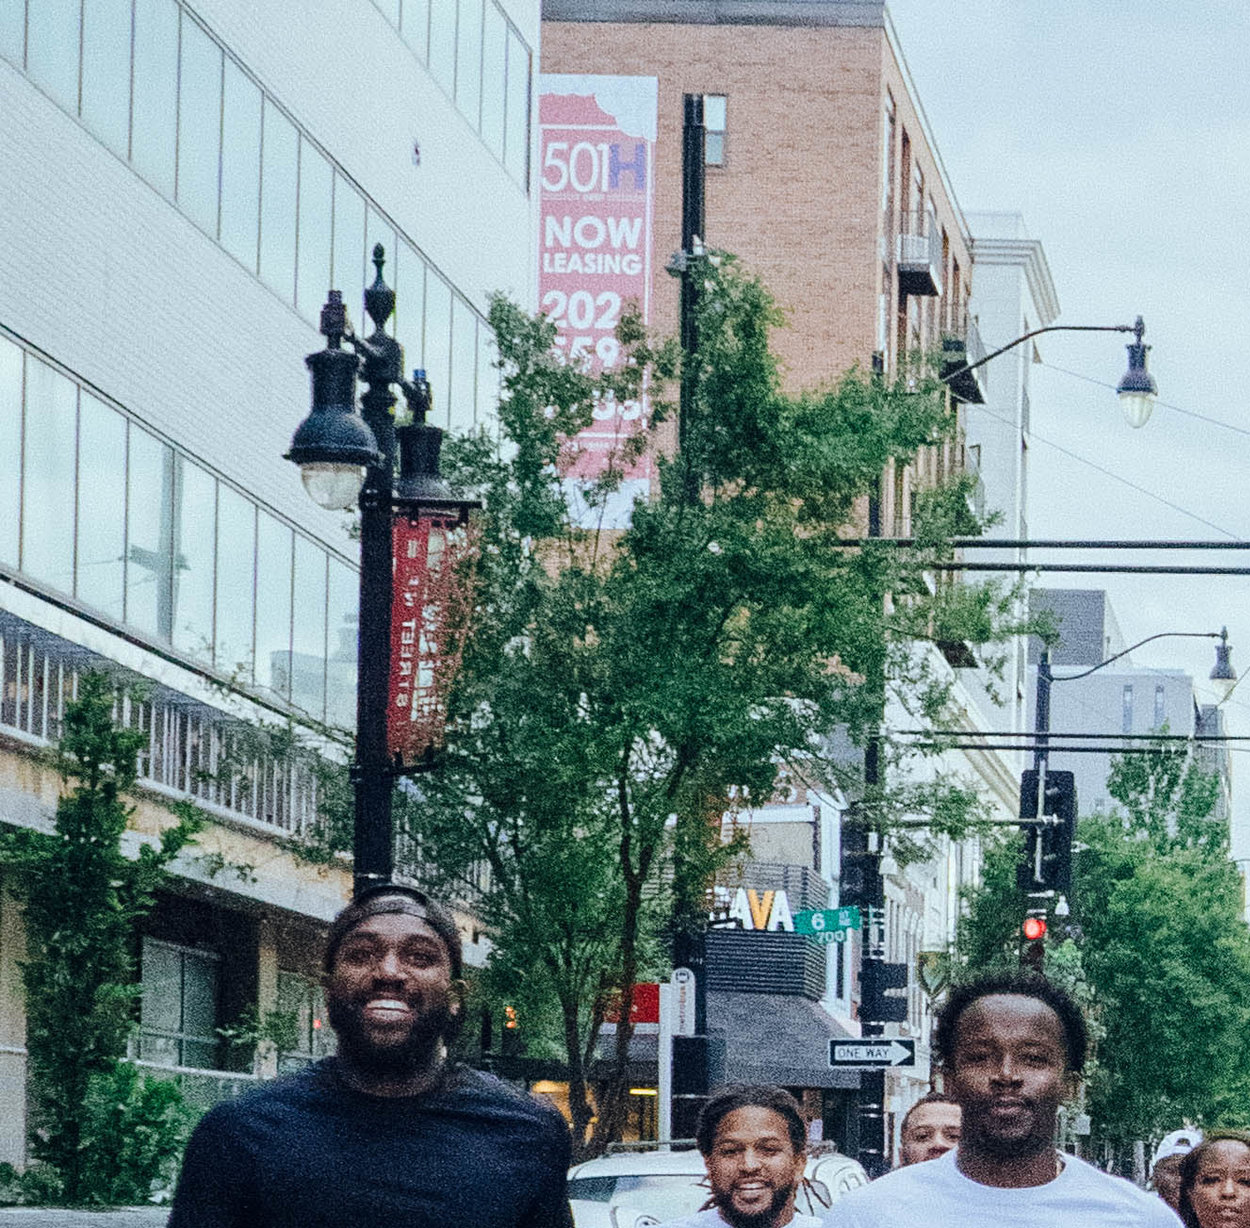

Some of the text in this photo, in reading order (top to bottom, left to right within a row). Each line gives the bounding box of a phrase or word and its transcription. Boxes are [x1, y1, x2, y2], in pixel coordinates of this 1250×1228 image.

[541, 141, 646, 193] 501H
[544, 214, 644, 249] NOW
[542, 252, 643, 276] LEASING
[542, 289, 622, 330] 202
[811, 912, 825, 930] 6
[816, 930, 845, 944] 700
[838, 1047, 889, 1058] ONE WAY
